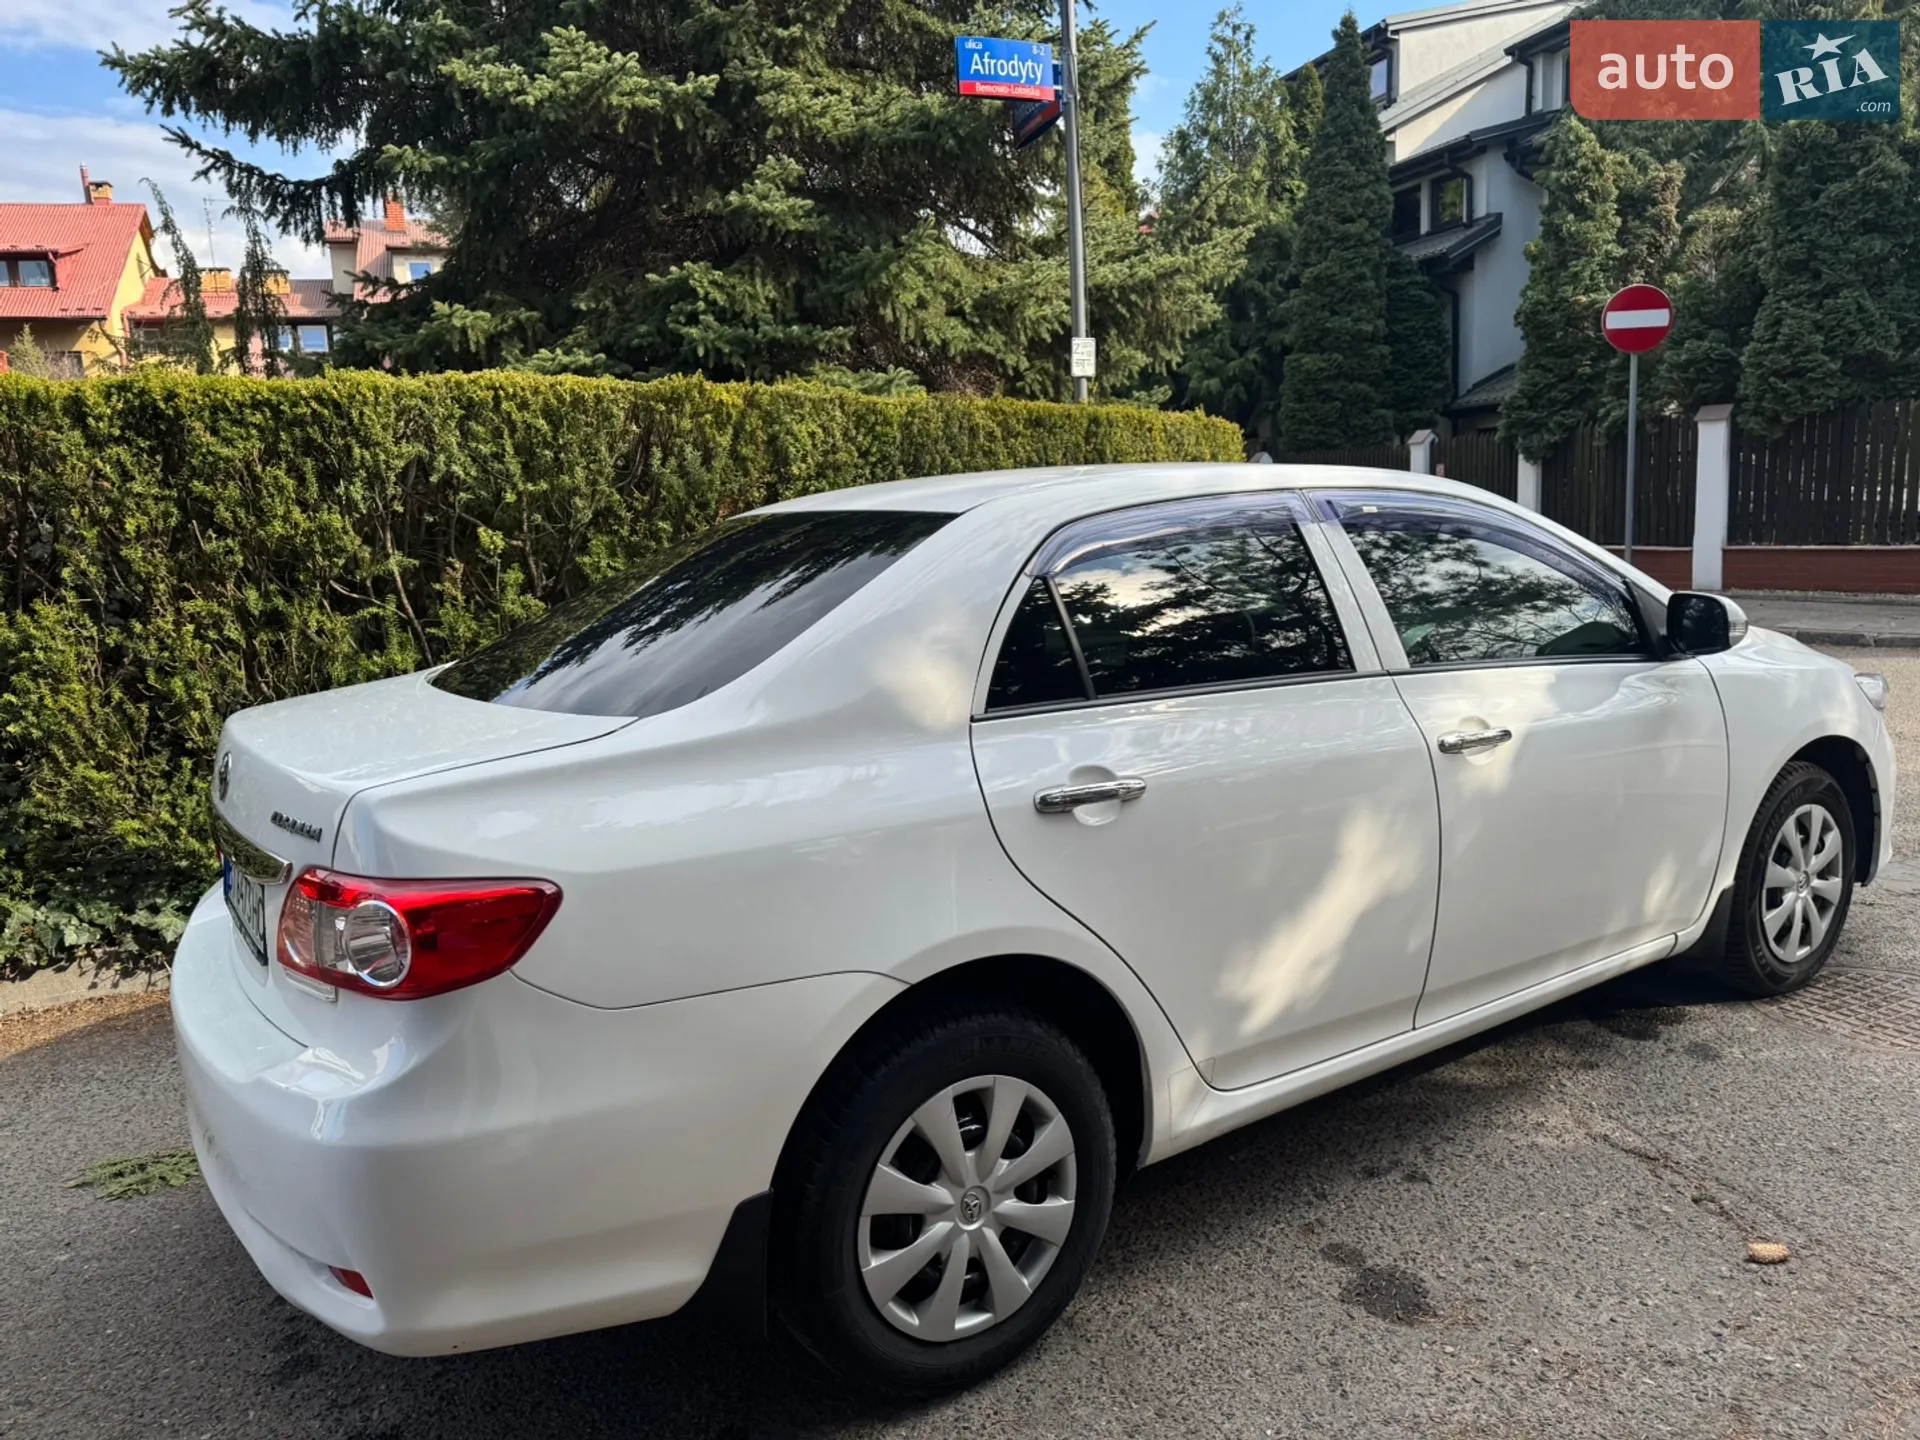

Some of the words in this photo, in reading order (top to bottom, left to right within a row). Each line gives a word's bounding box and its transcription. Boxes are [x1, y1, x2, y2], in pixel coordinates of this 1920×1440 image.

[965, 39, 983, 50] ulica
[1032, 44, 1046, 56] 8-2
[970, 52, 1043, 84] Afrodyty
